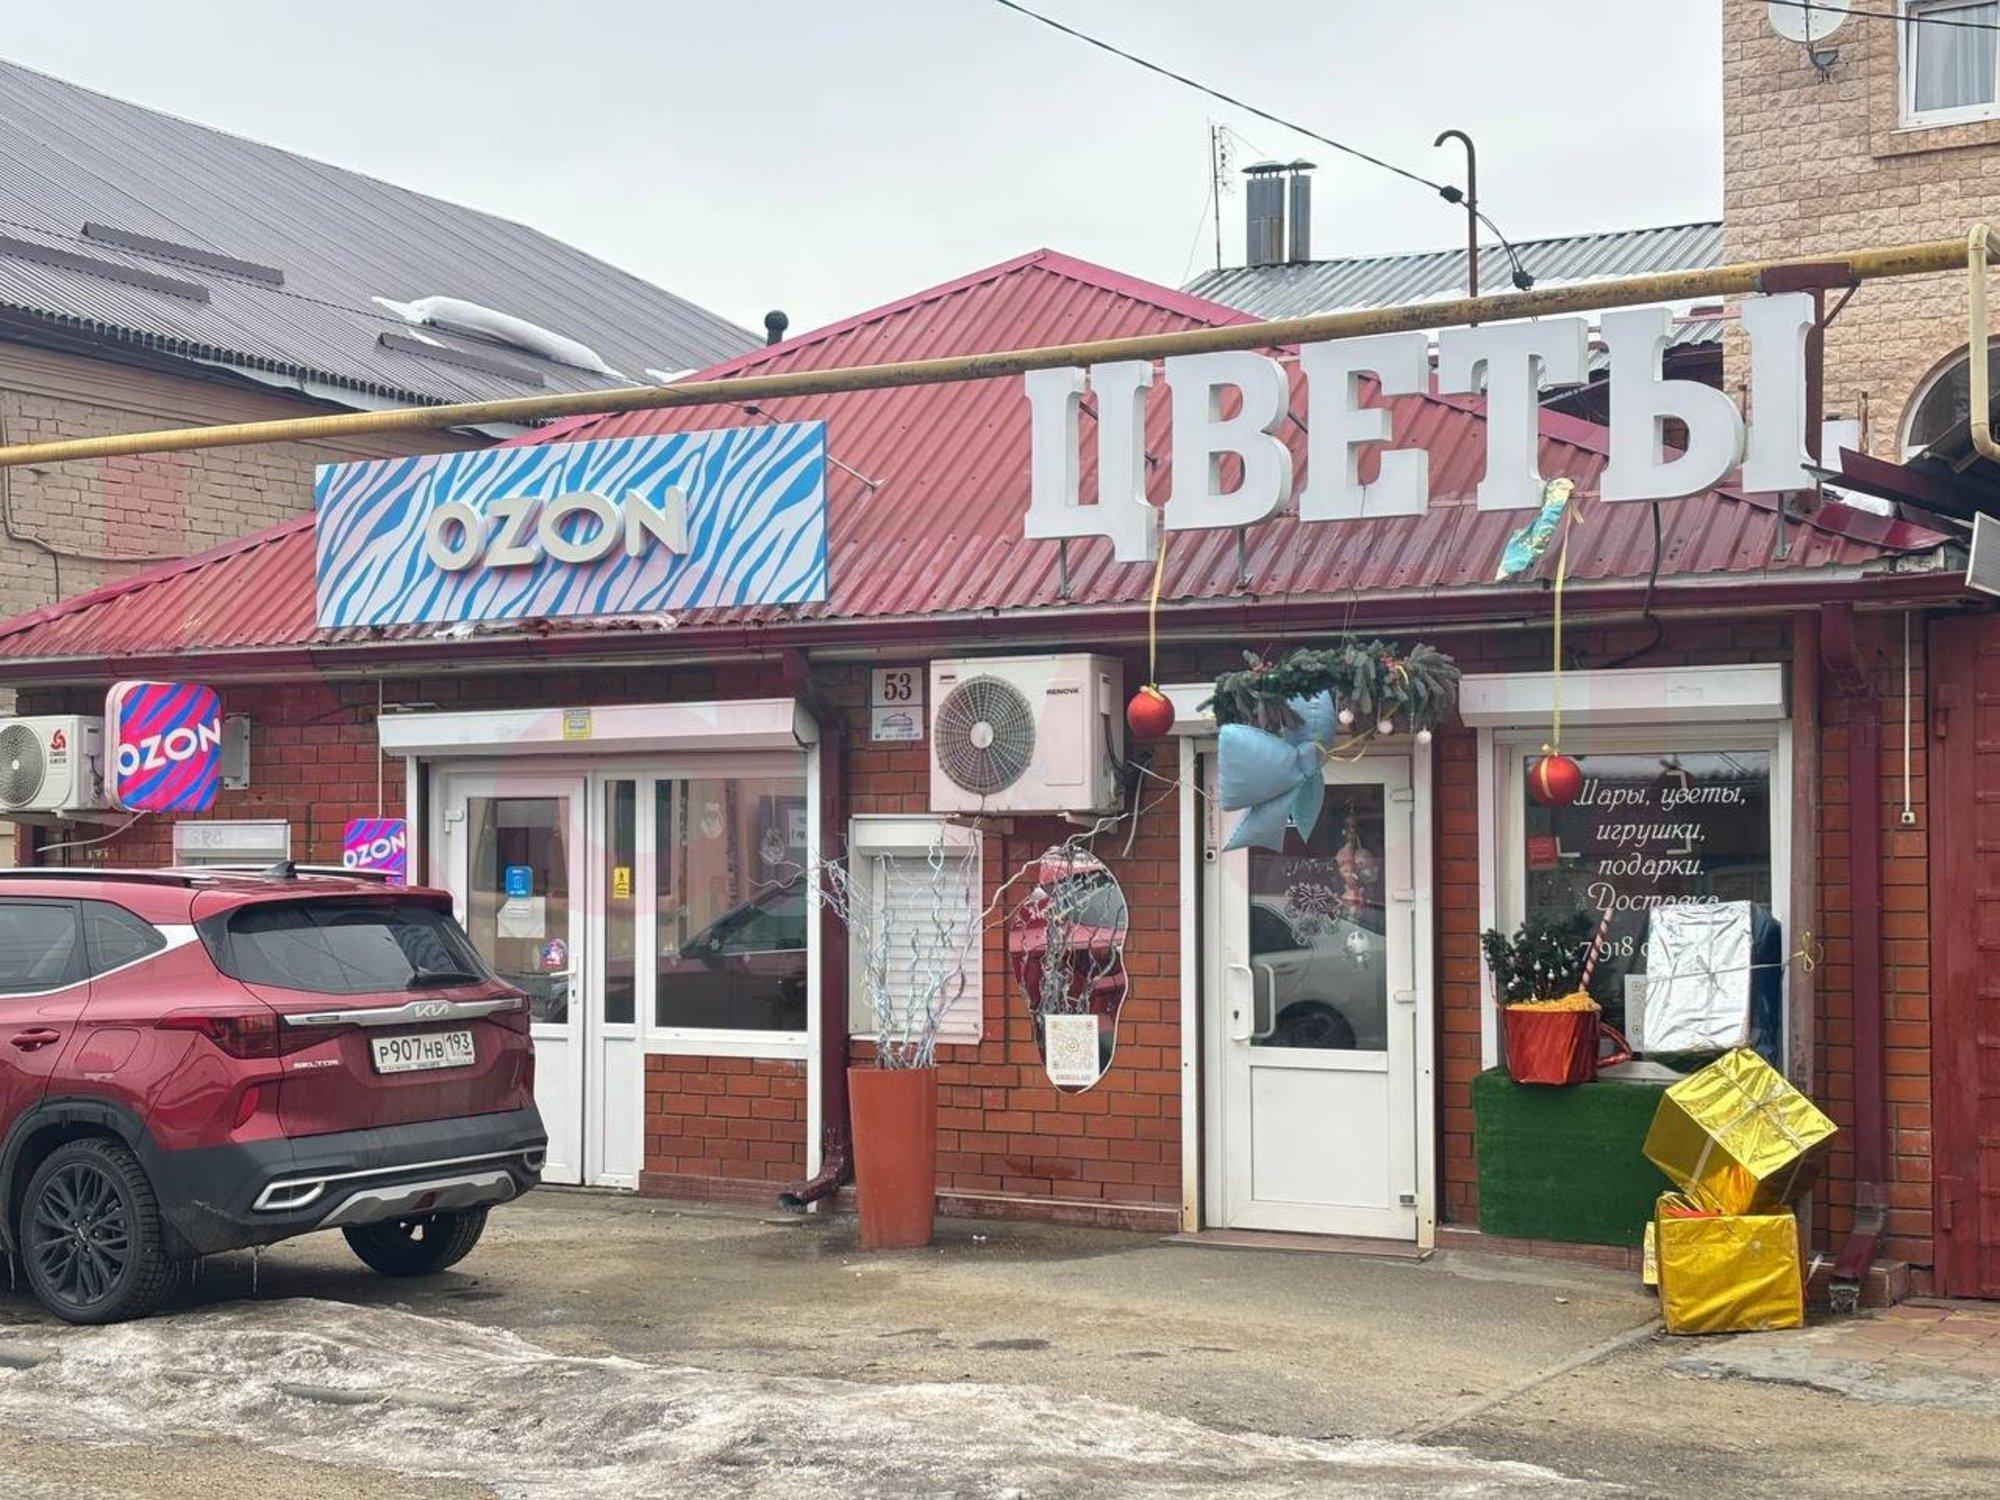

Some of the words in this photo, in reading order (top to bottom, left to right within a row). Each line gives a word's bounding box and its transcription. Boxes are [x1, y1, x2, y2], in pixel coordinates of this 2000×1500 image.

[1024, 293, 1818, 562] ЦВЕТЫ
[425, 486, 689, 571] OZON
[884, 673, 911, 700] 53
[117, 718, 221, 776] OZON
[1661, 785, 1747, 811] цветы,
[343, 831, 405, 869] OZON
[1596, 823, 1706, 848] игрушки,
[1598, 853, 1704, 884] подарки.
